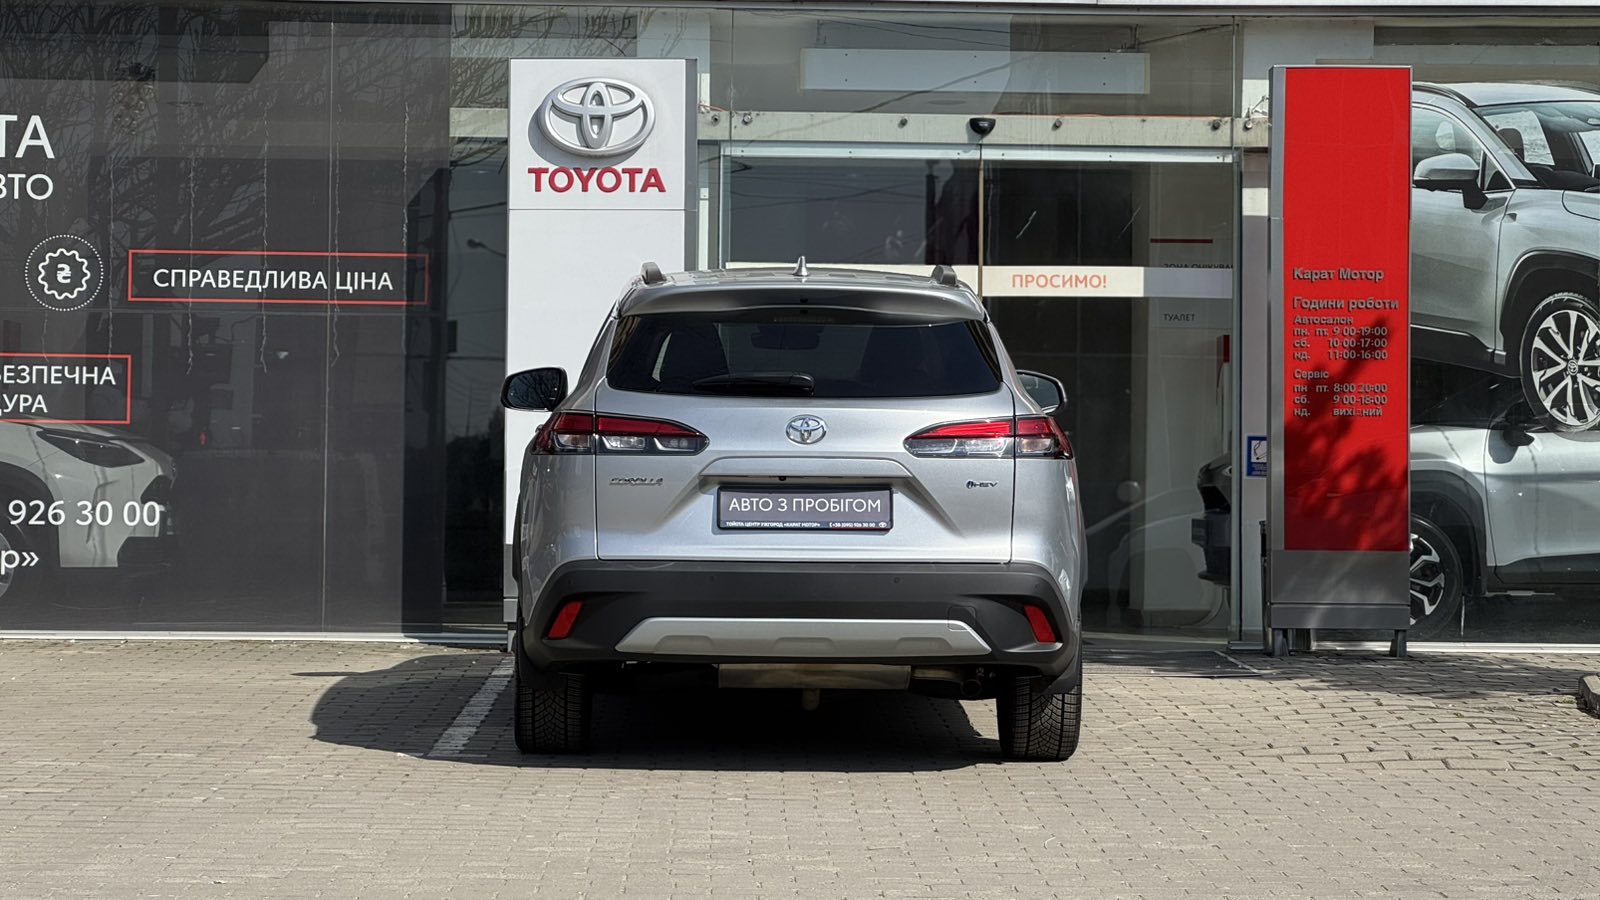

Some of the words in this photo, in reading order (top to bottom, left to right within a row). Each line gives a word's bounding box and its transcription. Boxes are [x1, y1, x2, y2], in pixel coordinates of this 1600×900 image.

[528, 166, 667, 193] TOYOTA
[153, 268, 328, 293] СПРАВЕДЛИВА
[335, 269, 394, 293] ЦІНА
[1011, 274, 1107, 289] ПРОСИМО!
[1293, 267, 1336, 282] Карат
[1338, 267, 1384, 282] Мотор
[1293, 296, 1345, 311] Години
[1348, 296, 1399, 311] роботи
[1163, 313, 1195, 321] ТУАЛЕТ
[1293, 315, 1353, 325] Автосалон
[0, 364, 116, 385] ЕЗПЕЧНА
[1294, 369, 1329, 381] Сервіс
[0, 394, 48, 415] УРА
[1333, 406, 1383, 416] вихіний
[729, 497, 773, 512] АВТО
[777, 497, 788, 512] З
[793, 498, 881, 513] ПРОБІГОМ
[8, 499, 66, 526] 926
[75, 500, 113, 526] 30
[123, 500, 161, 527] 00
